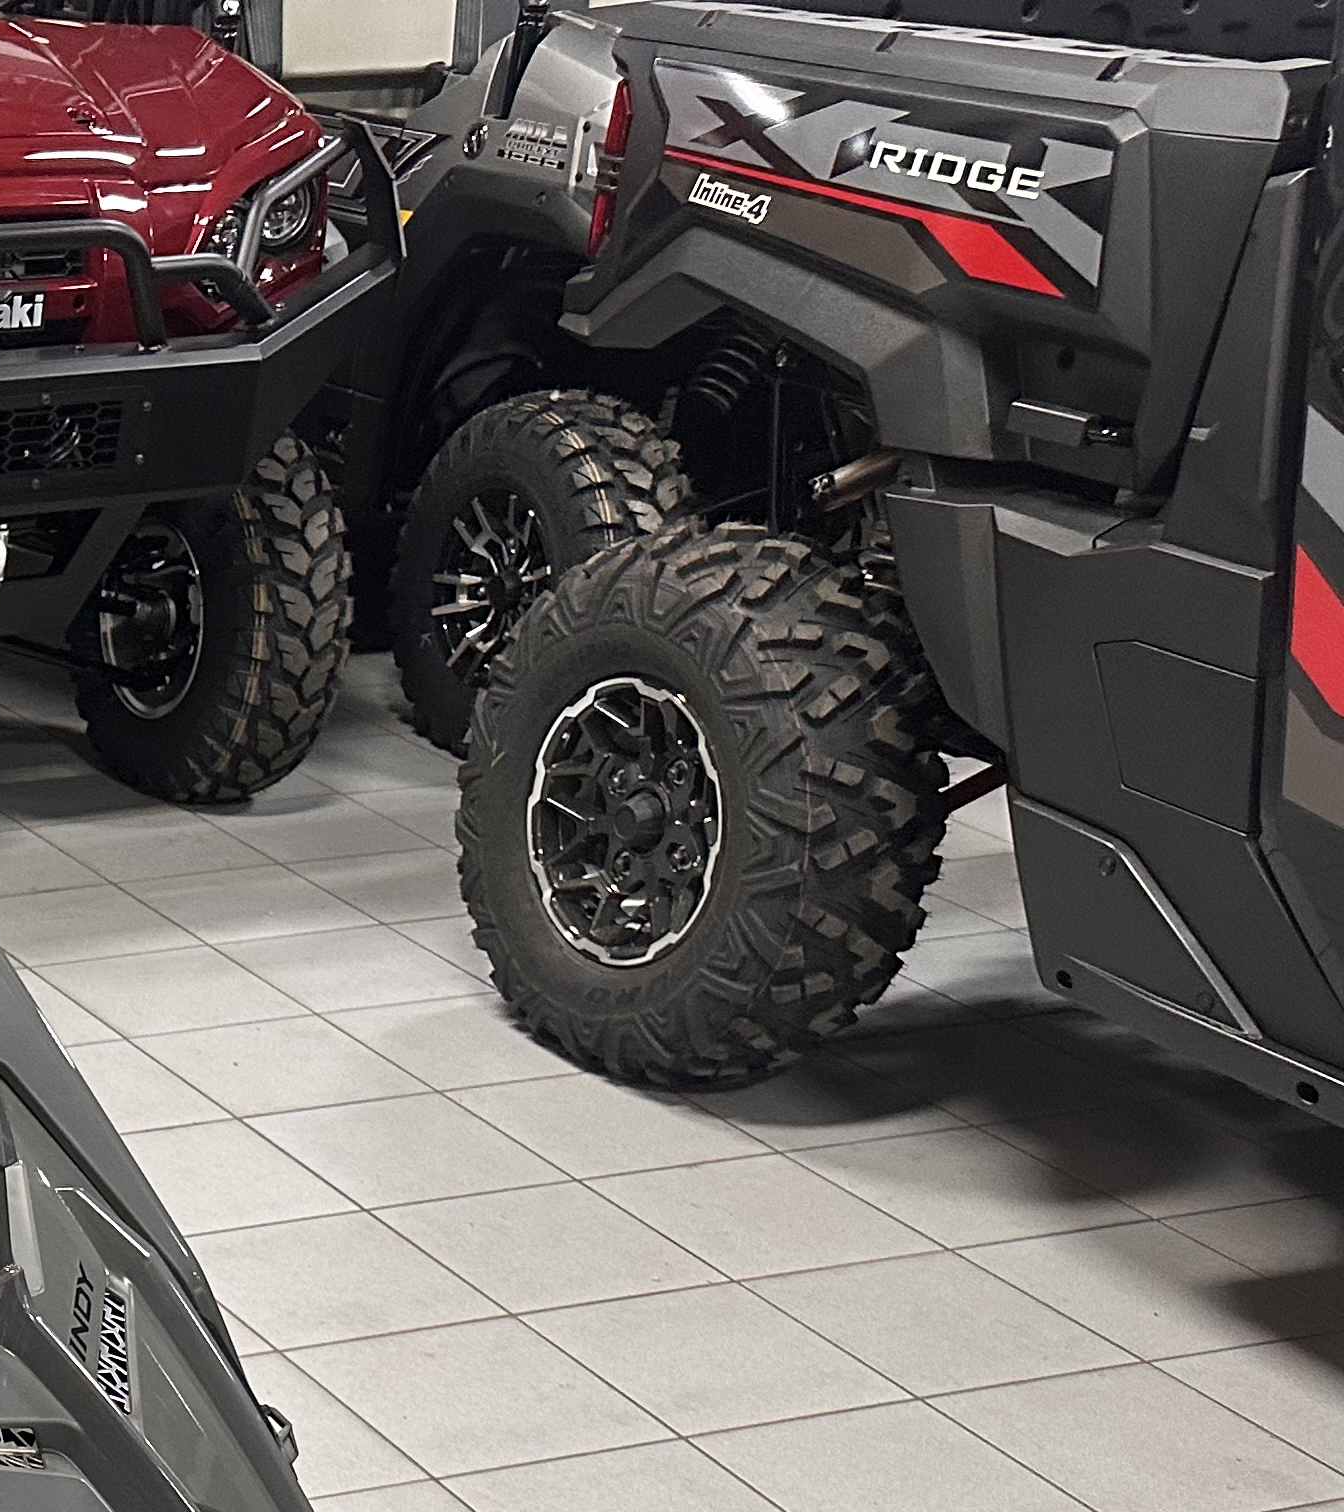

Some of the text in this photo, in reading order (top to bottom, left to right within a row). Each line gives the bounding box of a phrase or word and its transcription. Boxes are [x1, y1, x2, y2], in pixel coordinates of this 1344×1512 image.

[691, 175, 769, 221] Inline-4
[869, 140, 1046, 200] RIDGE
[69, 1260, 94, 1363] INDY
